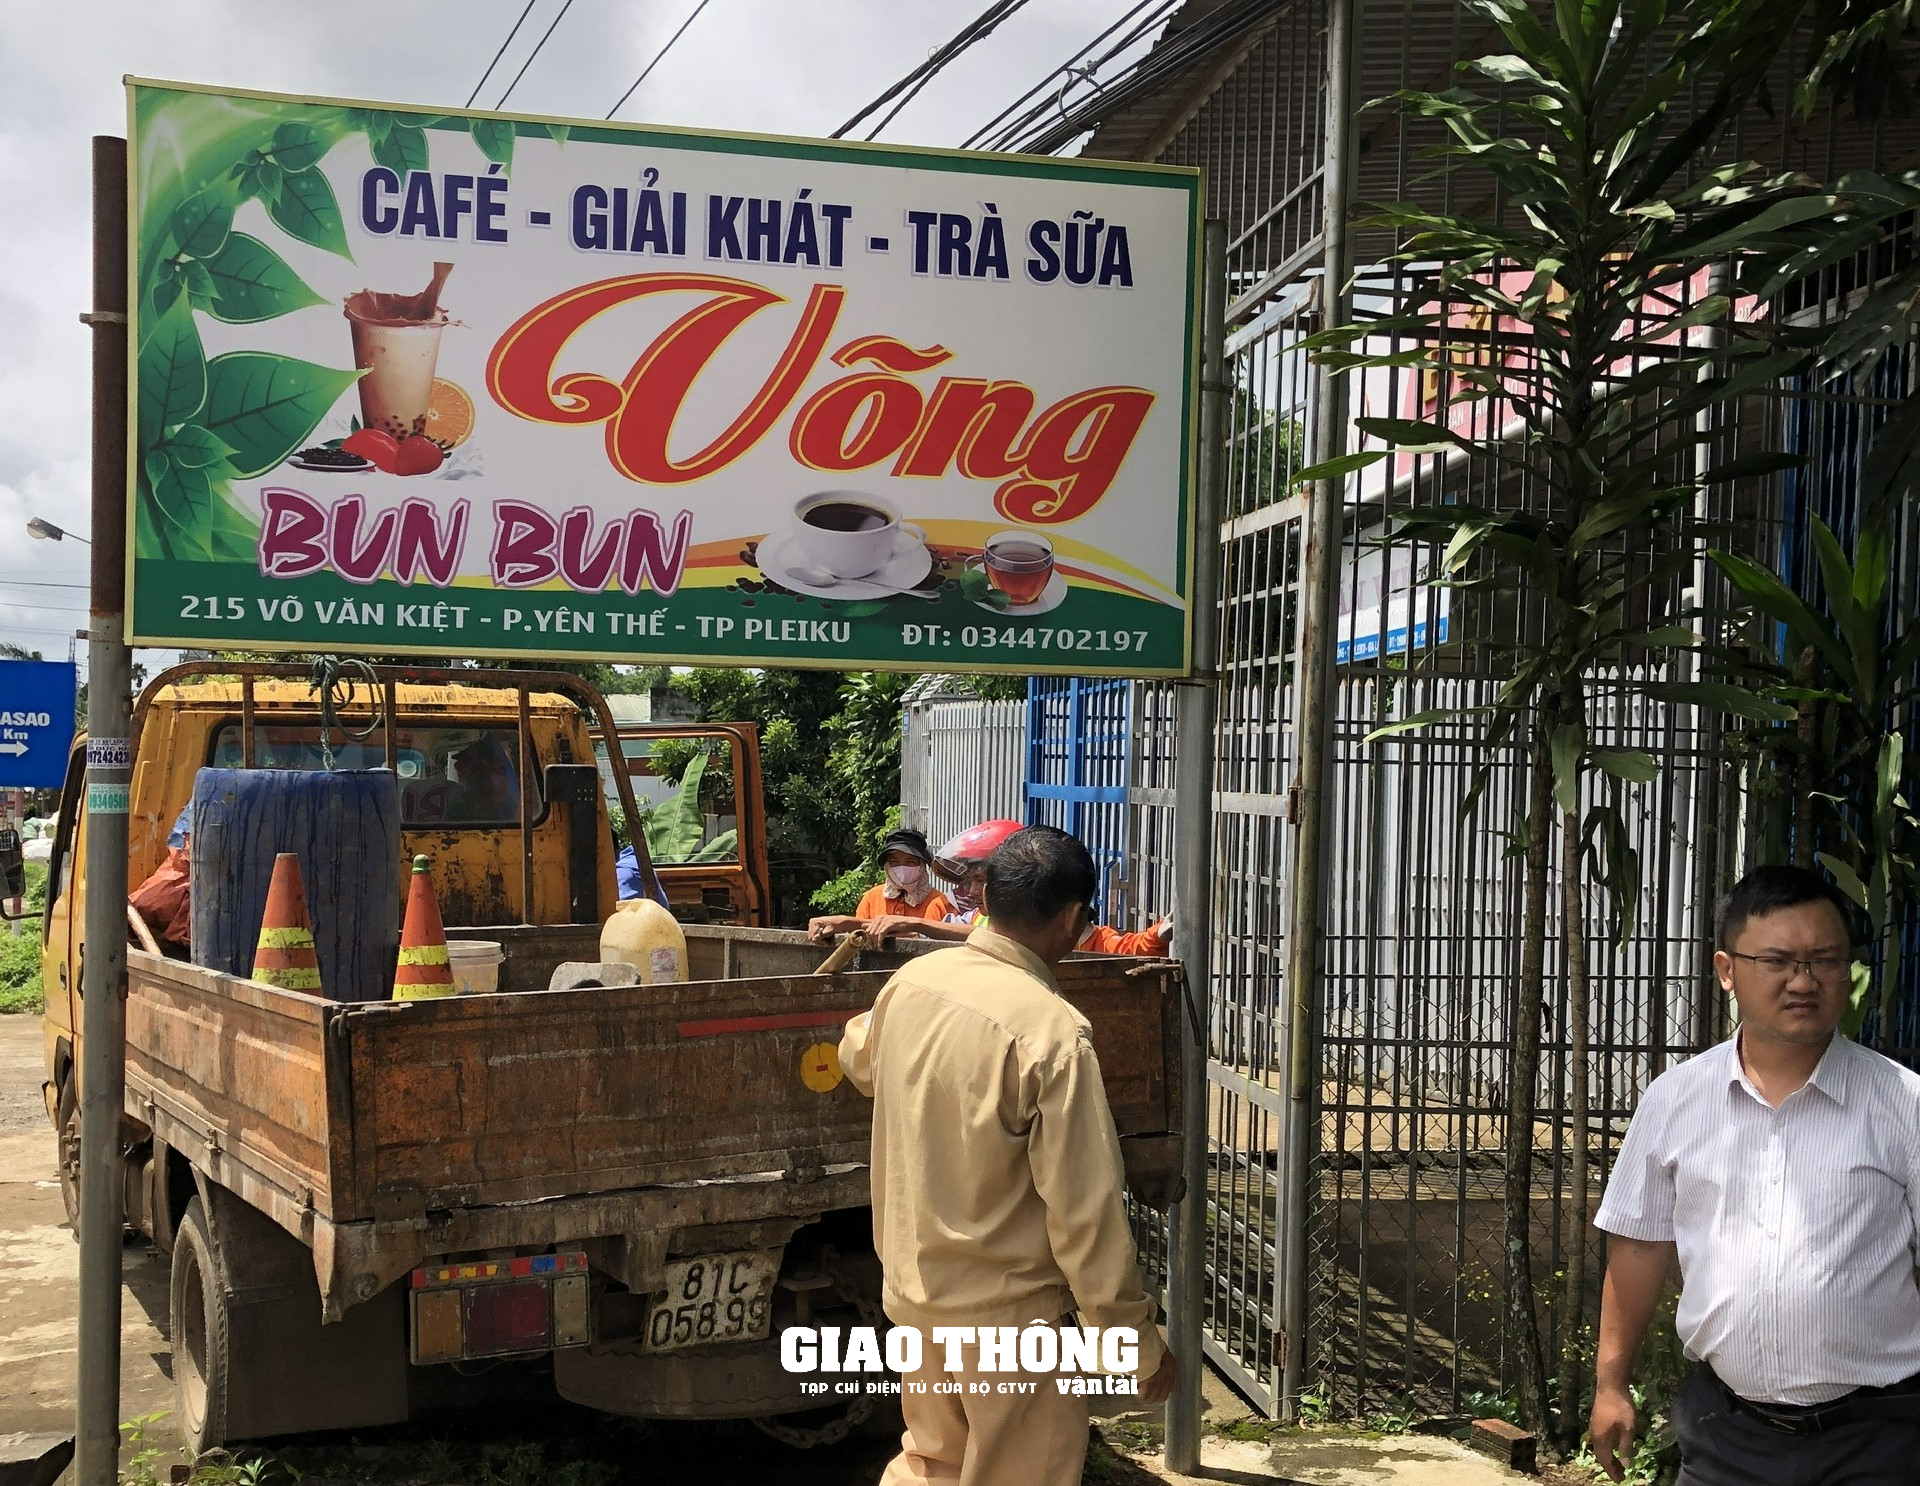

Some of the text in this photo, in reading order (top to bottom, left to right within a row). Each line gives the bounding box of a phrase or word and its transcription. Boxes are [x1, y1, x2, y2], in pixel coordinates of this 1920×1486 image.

[361, 163, 1135, 288] CAFÉ - GIẢI KHÁT - TRÀ SỮA
[485, 271, 1158, 526] Võng
[257, 486, 693, 598] BUN BUN
[180, 595, 245, 620] 215
[256, 596, 304, 622] VÕ
[314, 599, 385, 626] VĂN
[396, 602, 470, 632] KIỆT
[503, 606, 595, 634] P.YÊN
[605, 607, 669, 637] THẾ
[696, 616, 734, 640] TP
[745, 618, 851, 643] PLEIKU
[902, 625, 951, 647] ĐT:
[961, 626, 1149, 653] 0344702197
[3, 728, 28, 740] Km
[683, 1259, 750, 1301] 81C
[650, 1296, 768, 1348] 058.99
